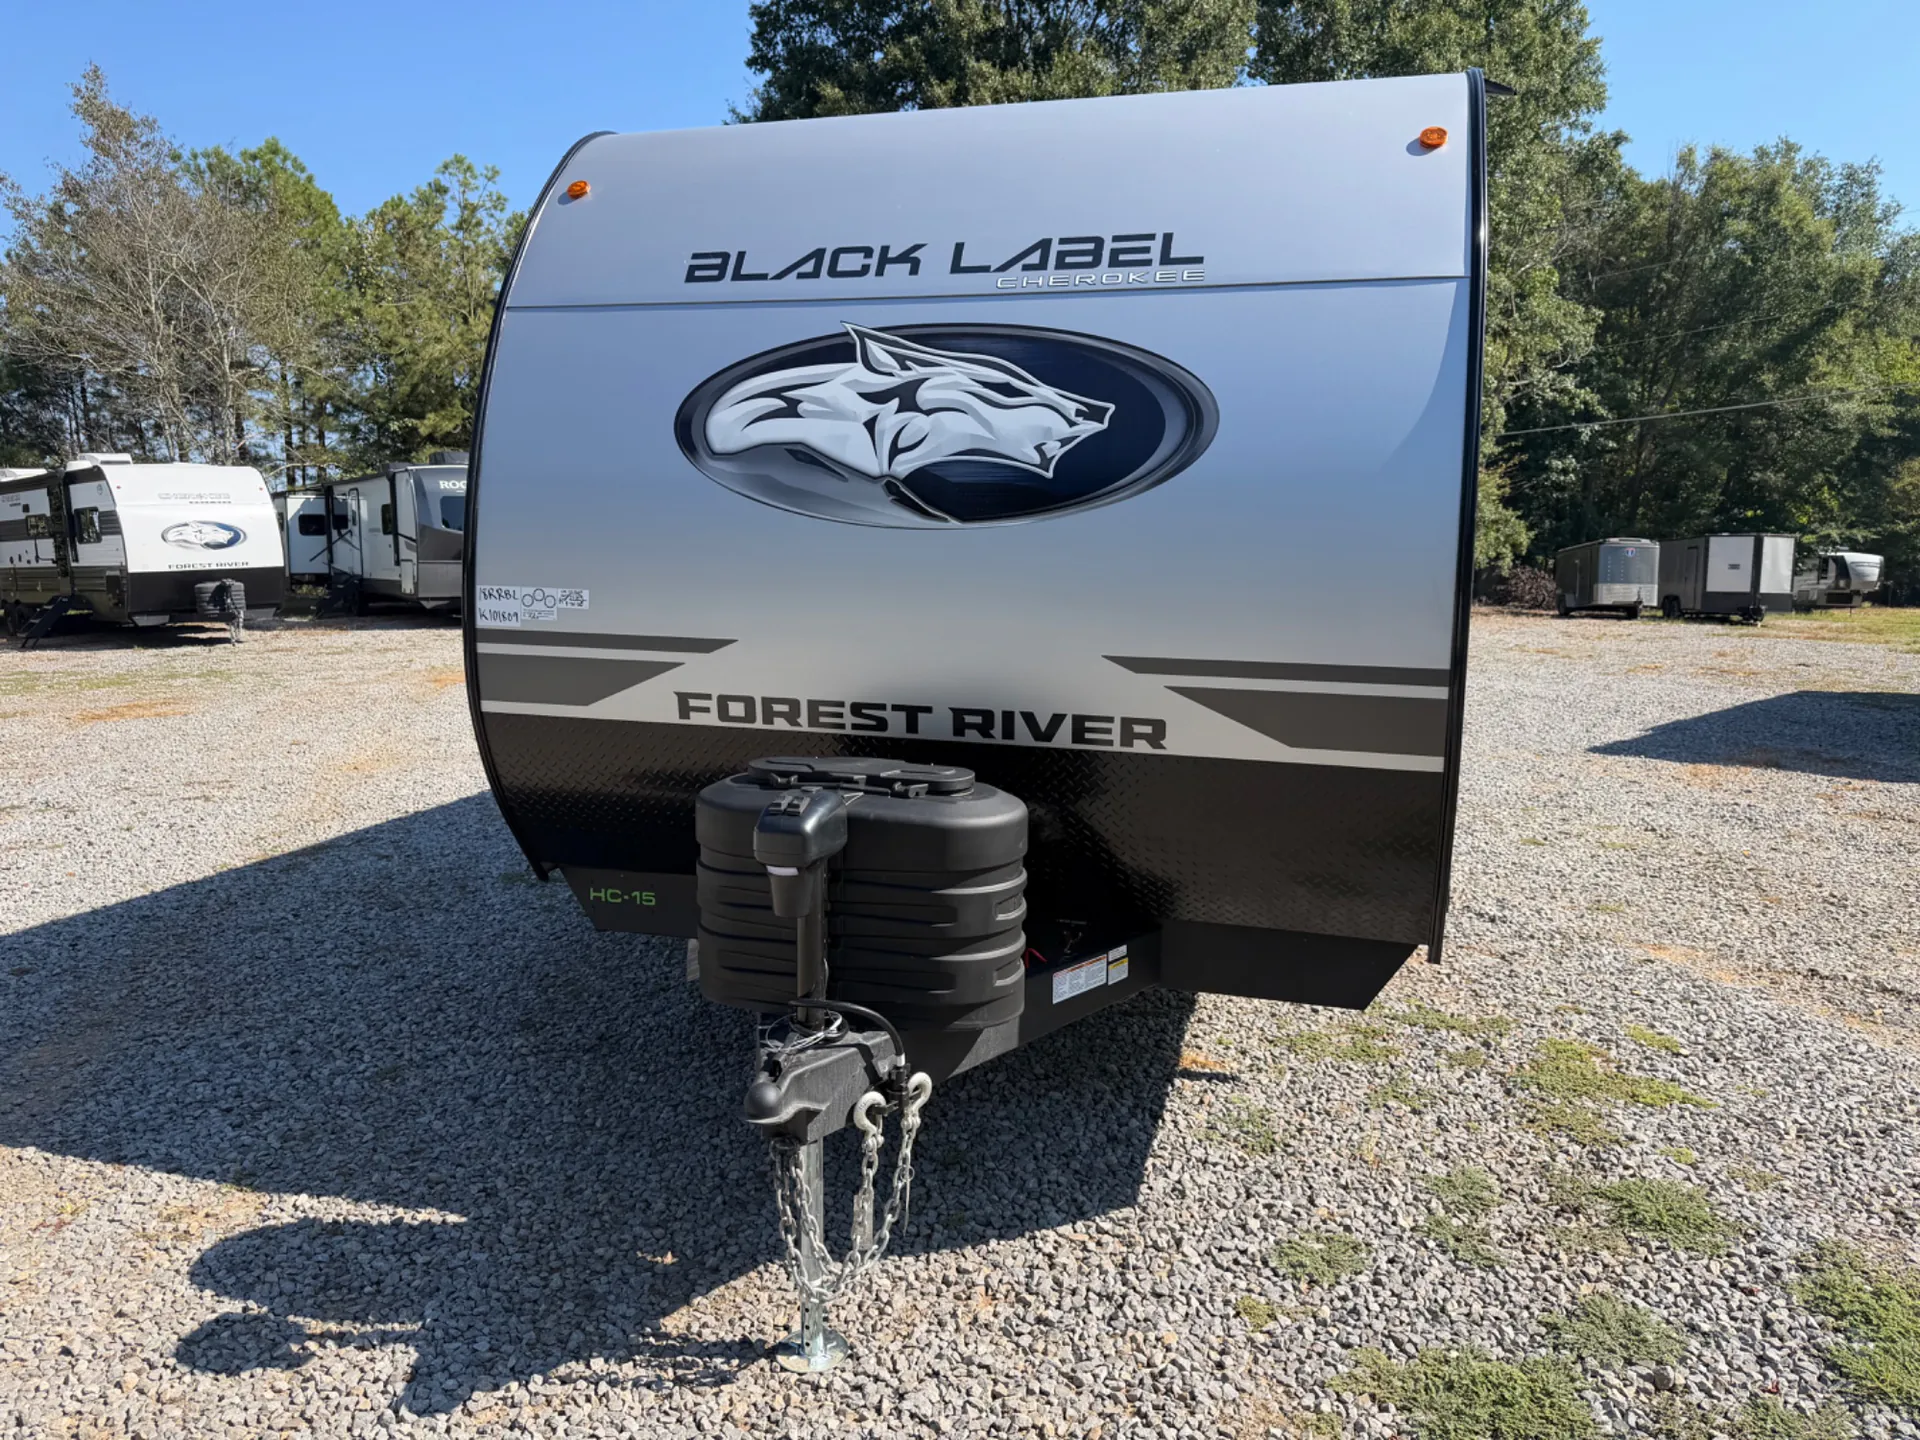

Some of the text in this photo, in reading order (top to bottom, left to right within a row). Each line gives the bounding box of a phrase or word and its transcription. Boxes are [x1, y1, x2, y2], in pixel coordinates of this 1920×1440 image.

[684, 232, 1205, 284] BLACK LABEL
[995, 269, 1206, 290] CHEROKEE
[168, 562, 213, 570] FOREST
[672, 690, 1168, 751] FOREST RIVER
[589, 887, 656, 906] HC-15
